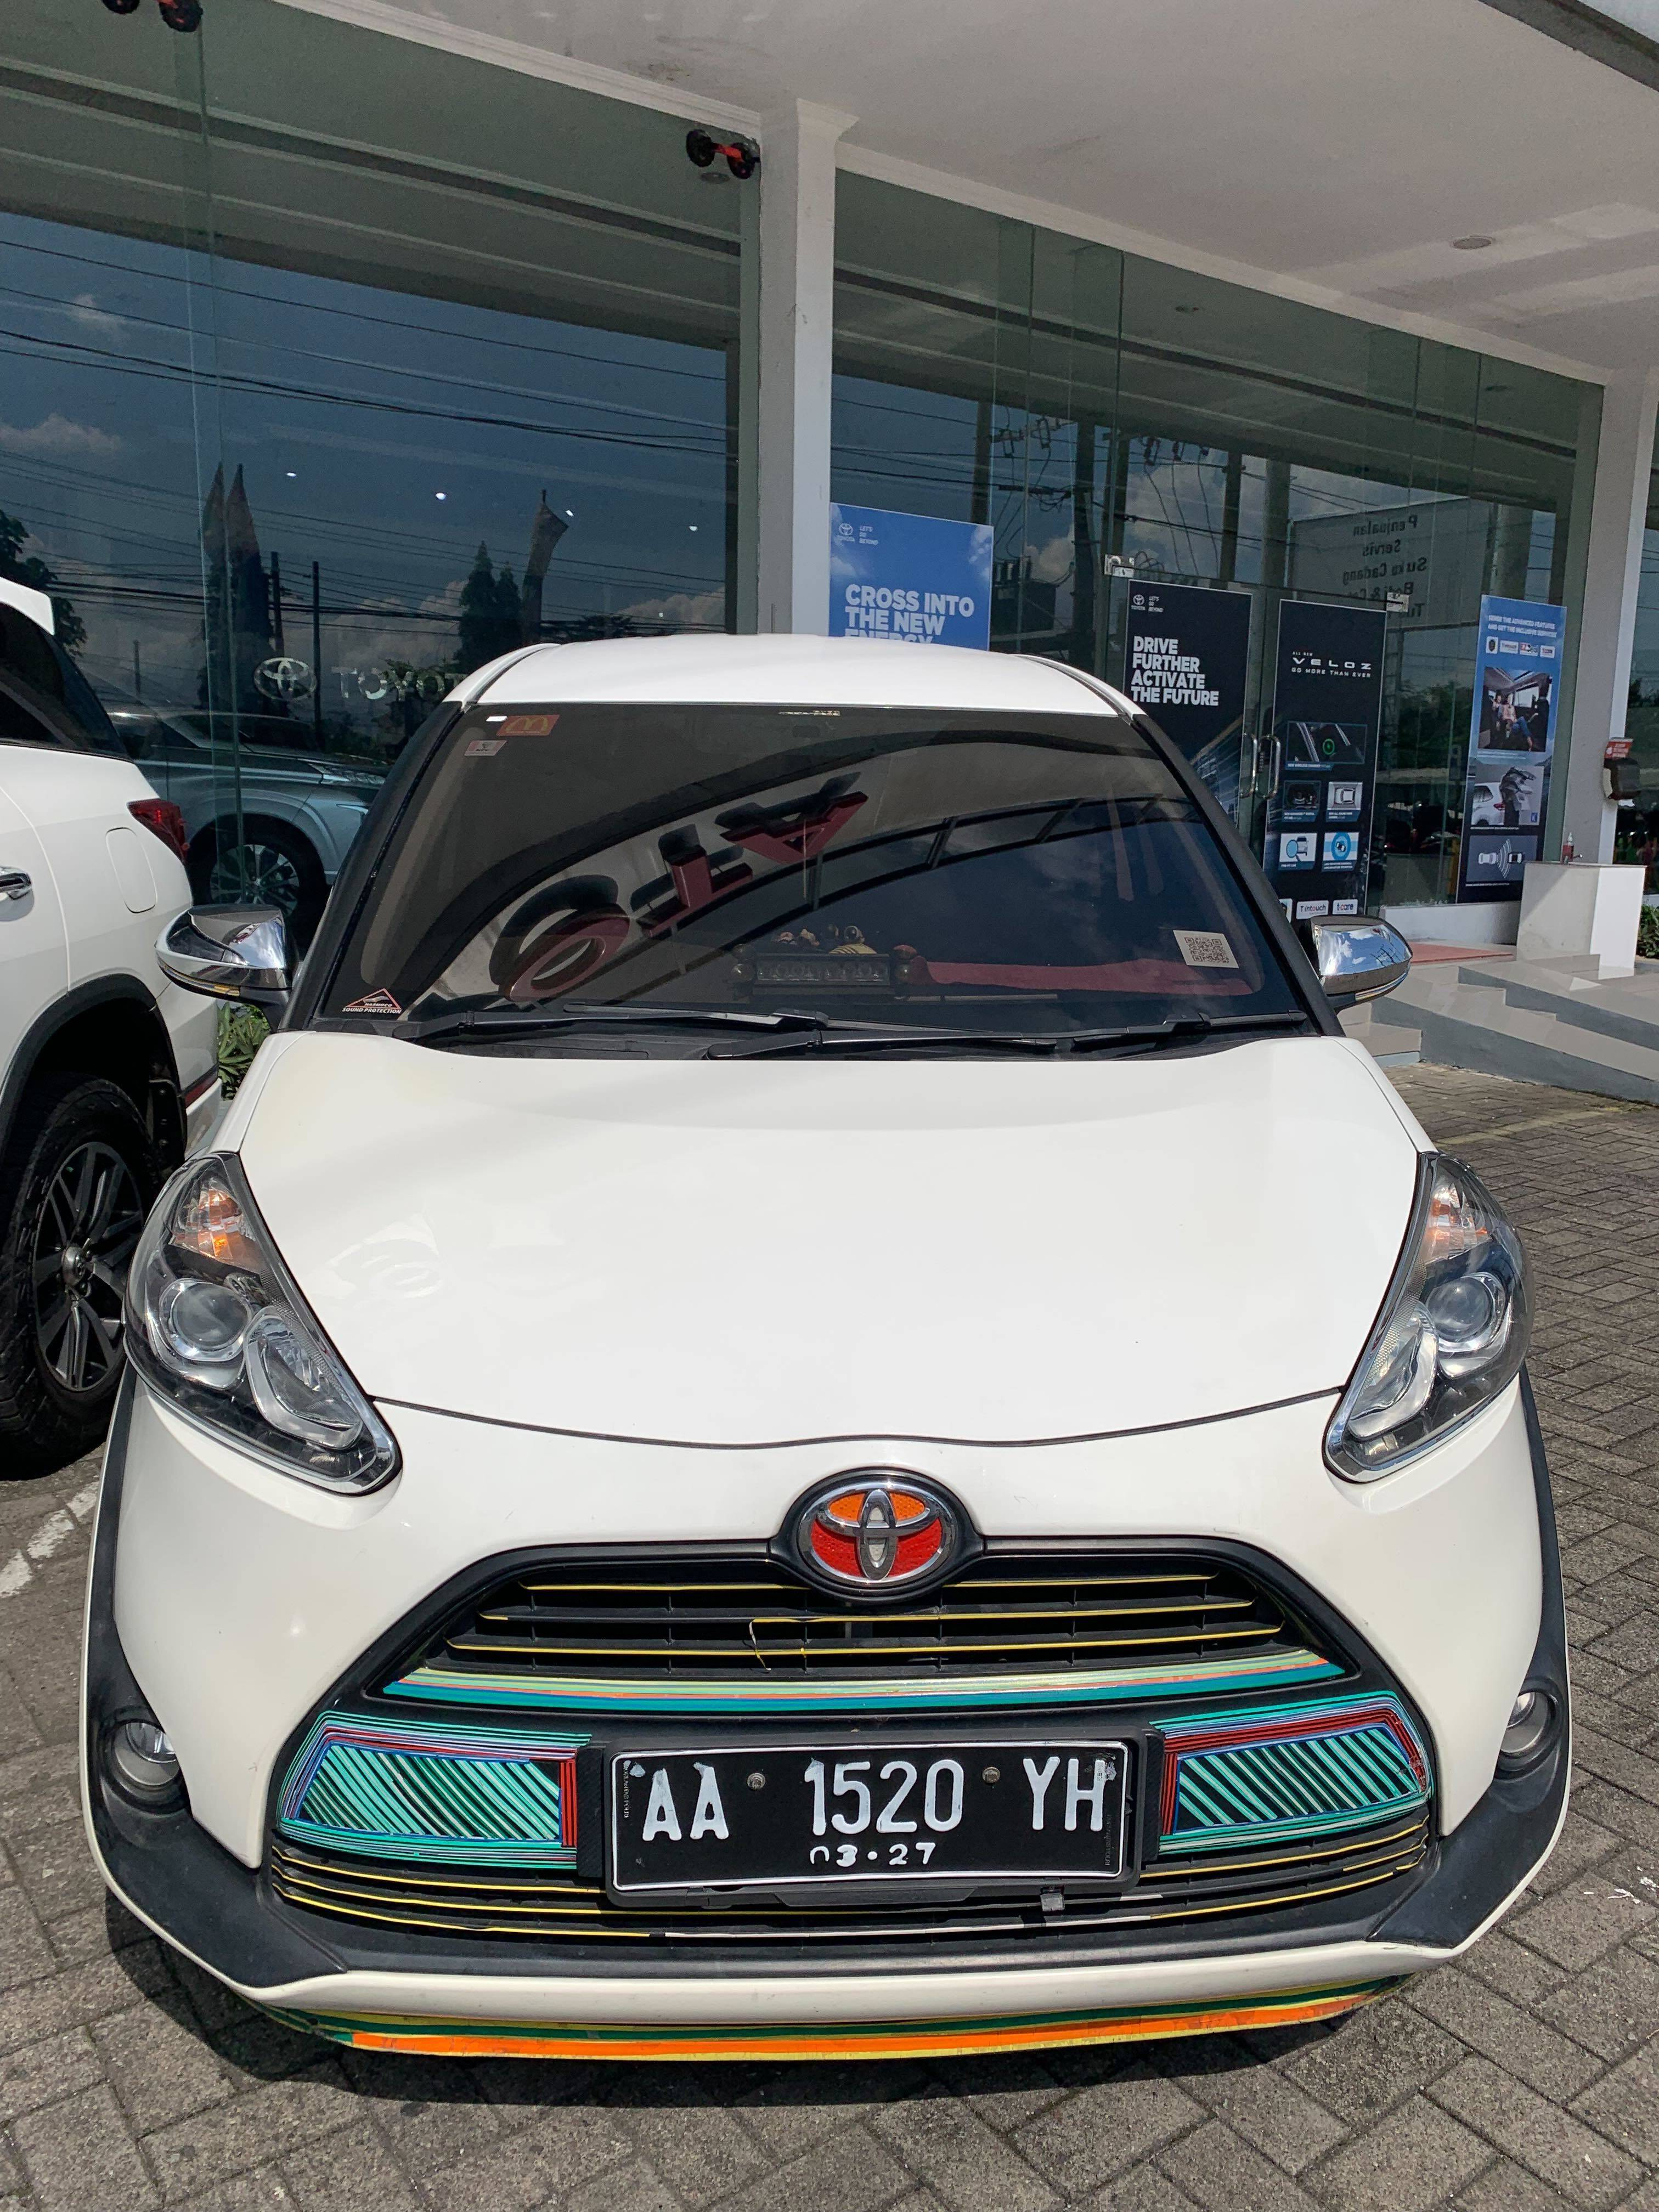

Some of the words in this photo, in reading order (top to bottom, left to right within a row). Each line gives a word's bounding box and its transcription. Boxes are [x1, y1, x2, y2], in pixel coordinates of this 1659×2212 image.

[845, 584, 919, 611] CROSS
[924, 592, 975, 617] INTO
[845, 606, 889, 630] THE
[894, 611, 946, 636] NEW
[1133, 636, 1178, 654] DRIVE
[1132, 653, 1200, 673] FURTHER
[1293, 657, 1371, 670] VELOZ
[1131, 669, 1206, 690] ACTIVATE
[1131, 686, 1160, 703] THE
[1163, 688, 1220, 707] FUTURE
[641, 1762, 730, 1841] AA
[804, 1757, 965, 1837] 1520
[1023, 1756, 1106, 1832] YH
